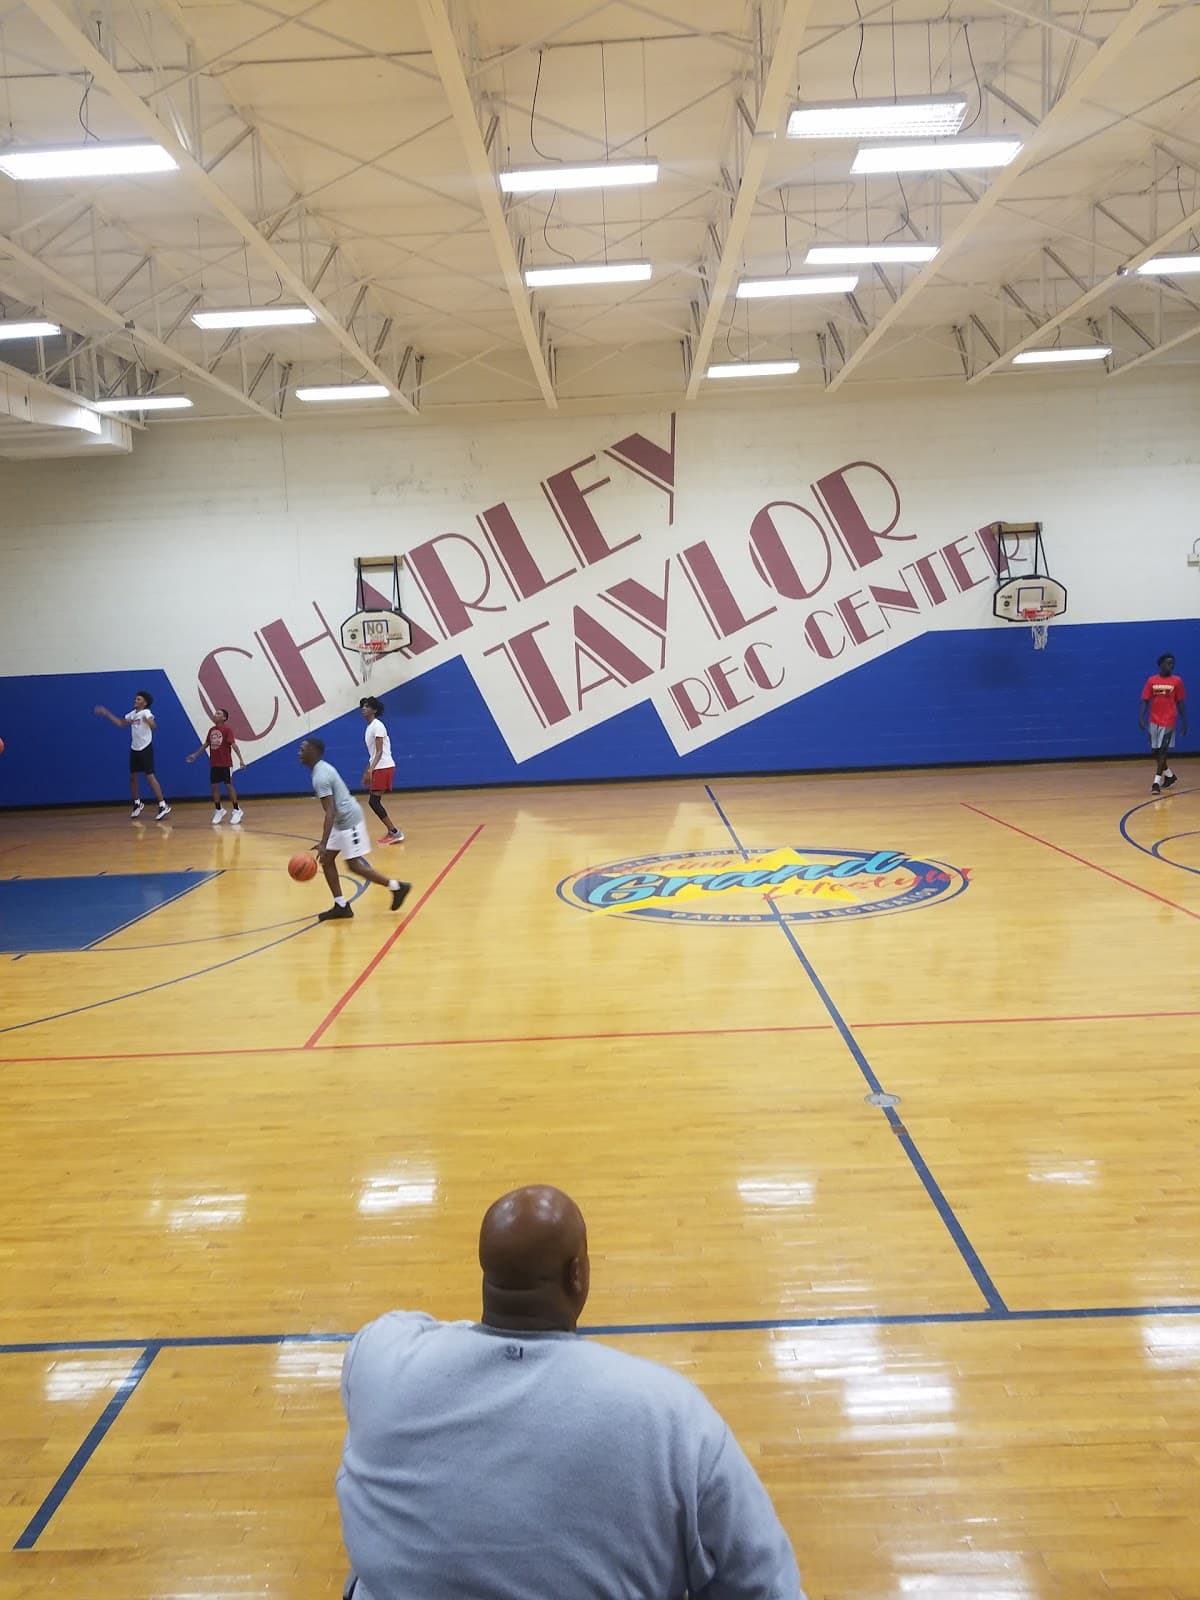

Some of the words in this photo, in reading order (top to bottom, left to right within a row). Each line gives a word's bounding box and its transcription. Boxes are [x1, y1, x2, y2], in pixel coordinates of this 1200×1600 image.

[483, 461, 917, 729] TAYLOR
[366, 622, 384, 635] NO
[667, 641, 785, 731] REC
[804, 521, 1027, 659] CENTER
[587, 851, 909, 908] Grand
[671, 913, 763, 921] PARKS
